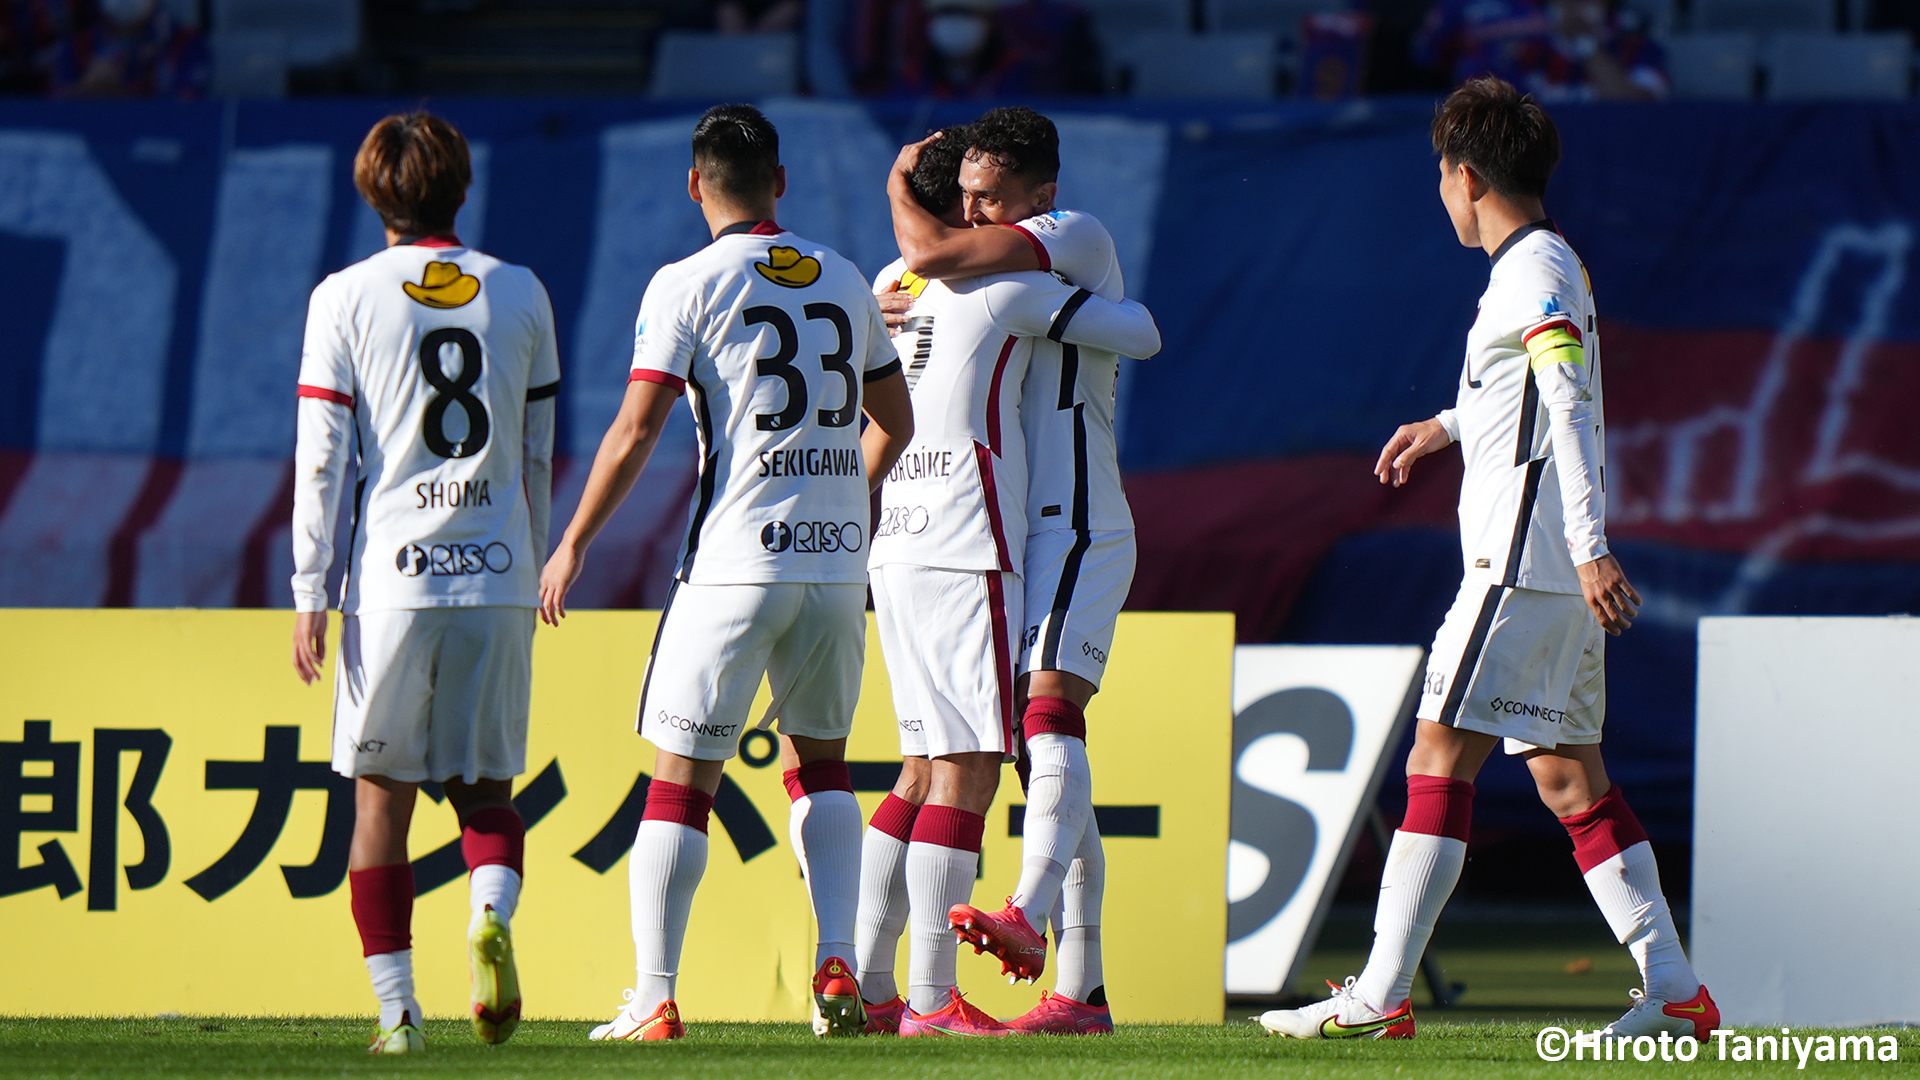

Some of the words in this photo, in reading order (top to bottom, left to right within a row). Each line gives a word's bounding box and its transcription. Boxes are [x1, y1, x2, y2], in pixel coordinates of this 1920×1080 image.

[742, 302, 859, 432] 33
[419, 327, 490, 460] 8
[759, 448, 859, 478] SEKIGAWA
[416, 478, 492, 510] SHOMA
[794, 521, 863, 553] RISO
[430, 541, 513, 577] RISO
[670, 715, 737, 738] CONNECT
[1503, 700, 1566, 725] CONNECT
